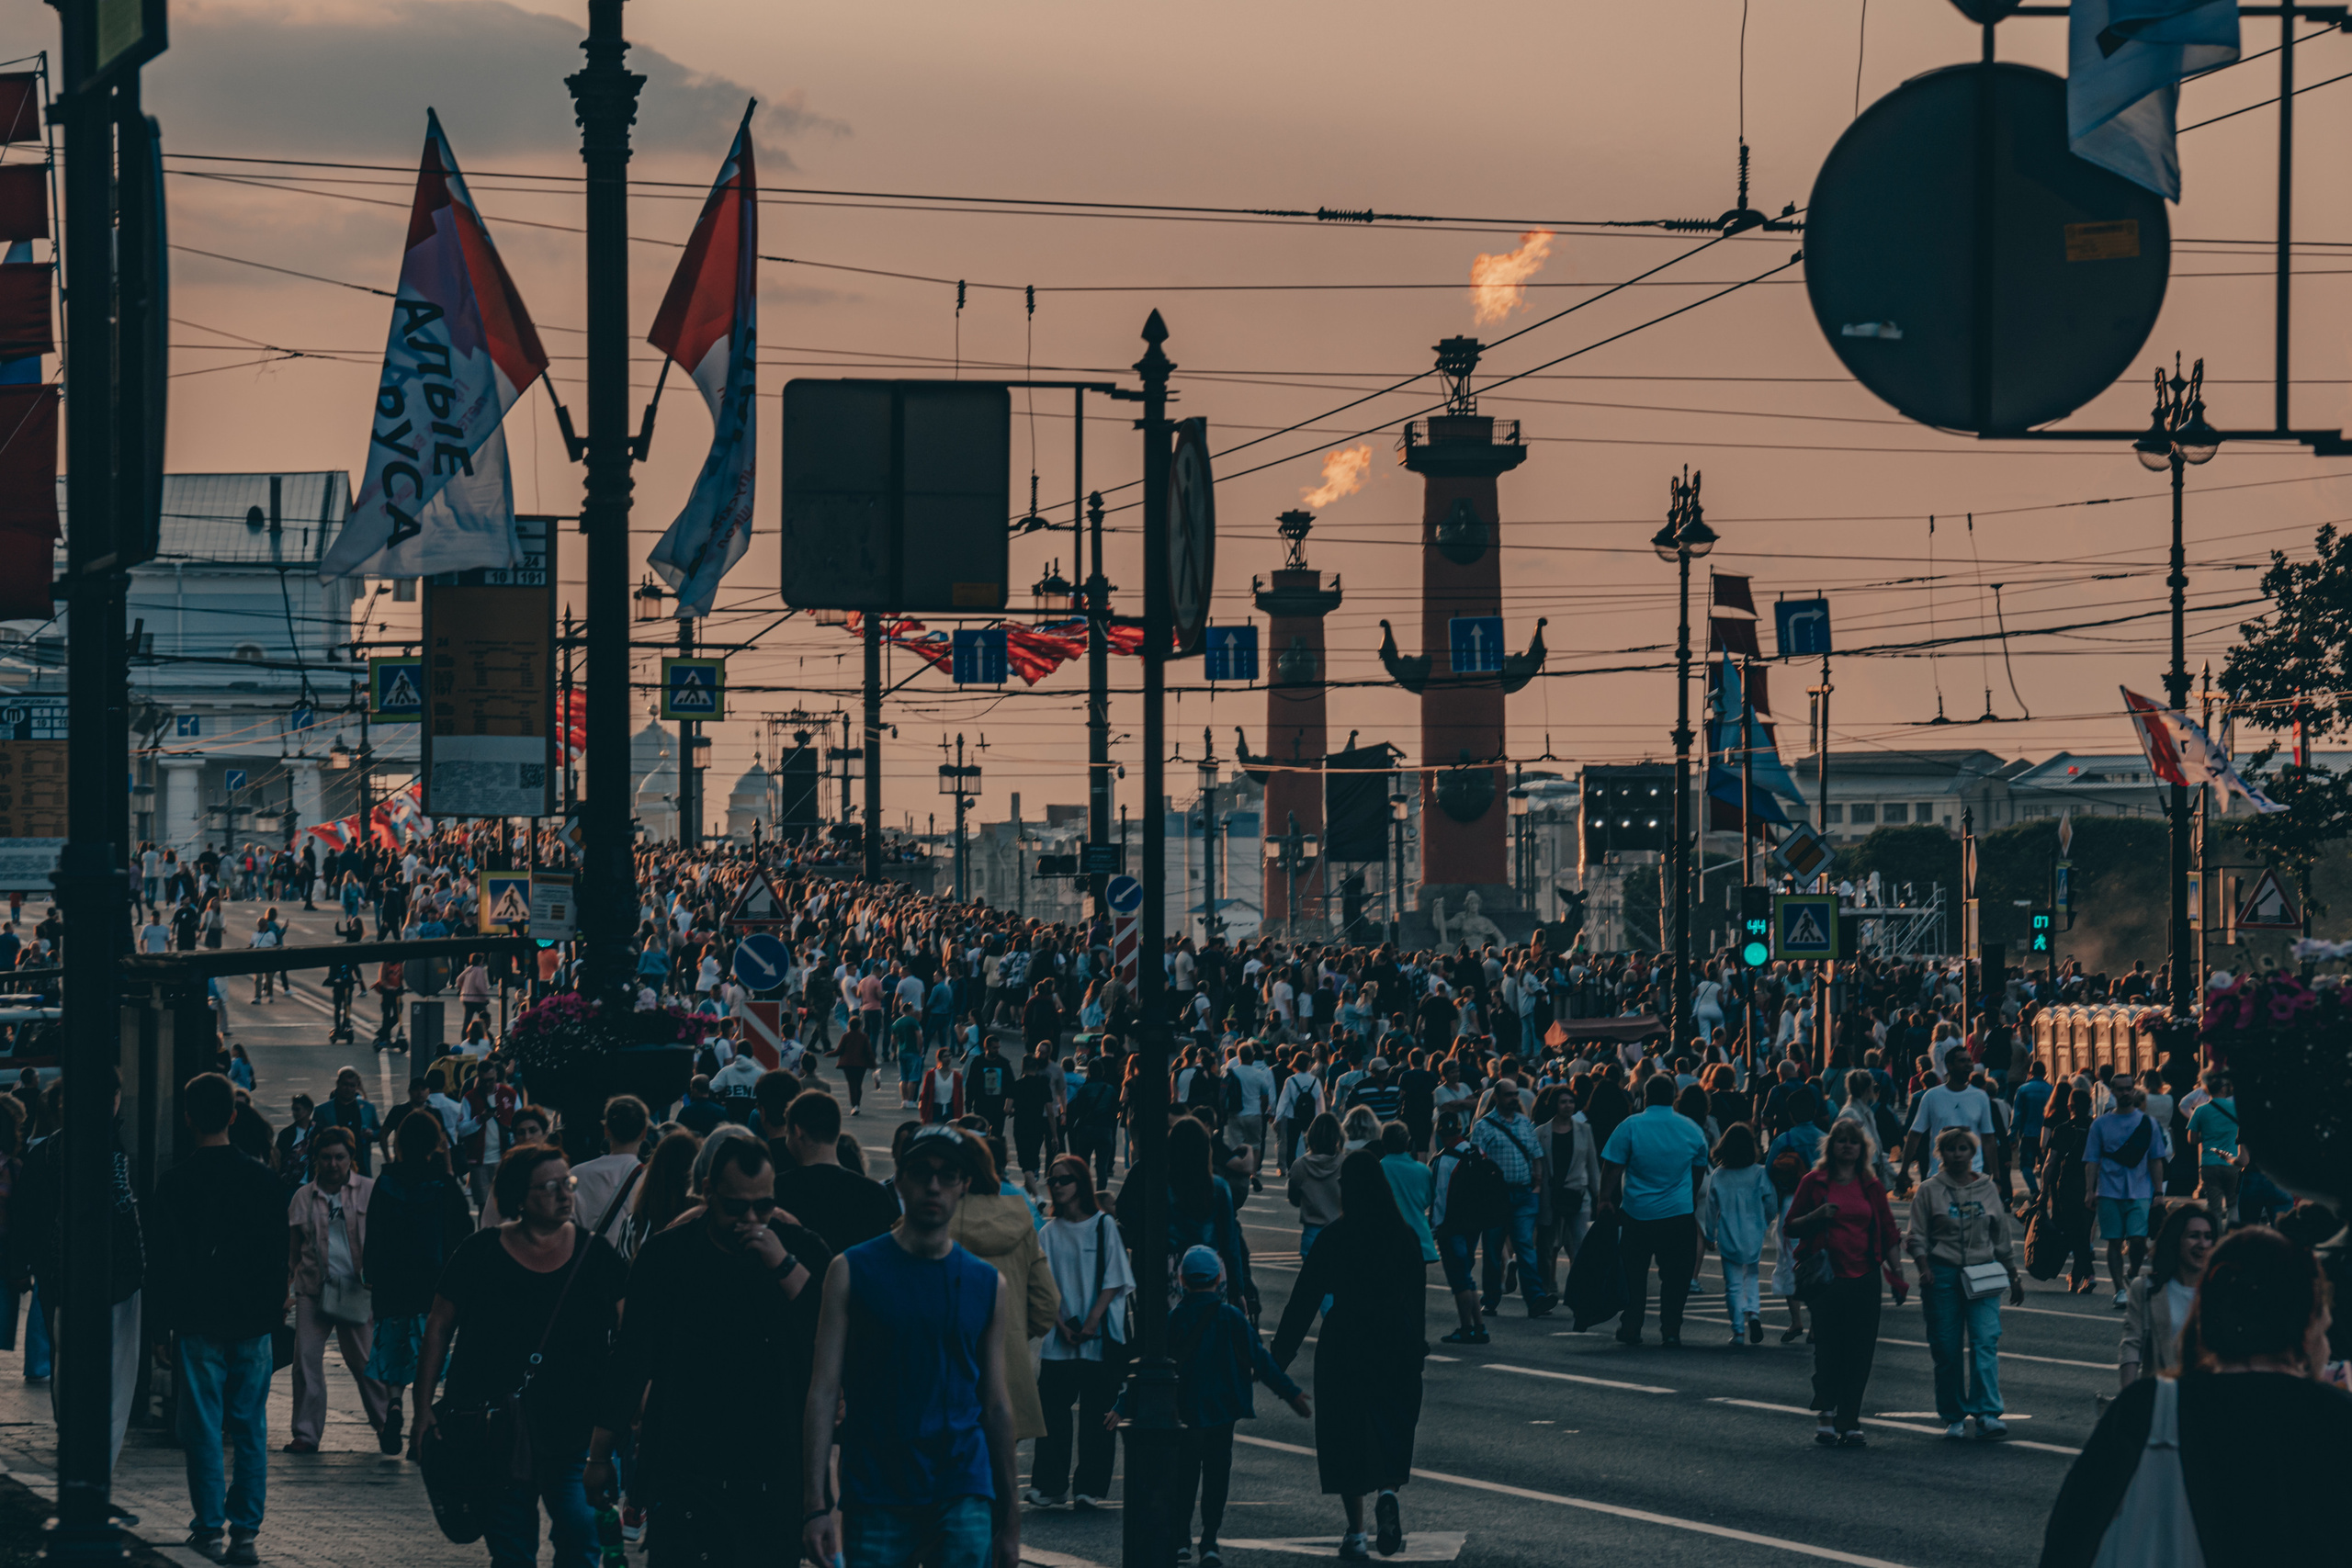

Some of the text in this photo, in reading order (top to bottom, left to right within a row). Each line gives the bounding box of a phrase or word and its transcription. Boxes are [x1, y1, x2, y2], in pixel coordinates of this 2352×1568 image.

[394, 299, 474, 477] АЛЫЕ
[524, 556, 539, 568] 24
[492, 571, 507, 583] 10
[521, 571, 542, 584] 191
[1747, 919, 1767, 935] 44
